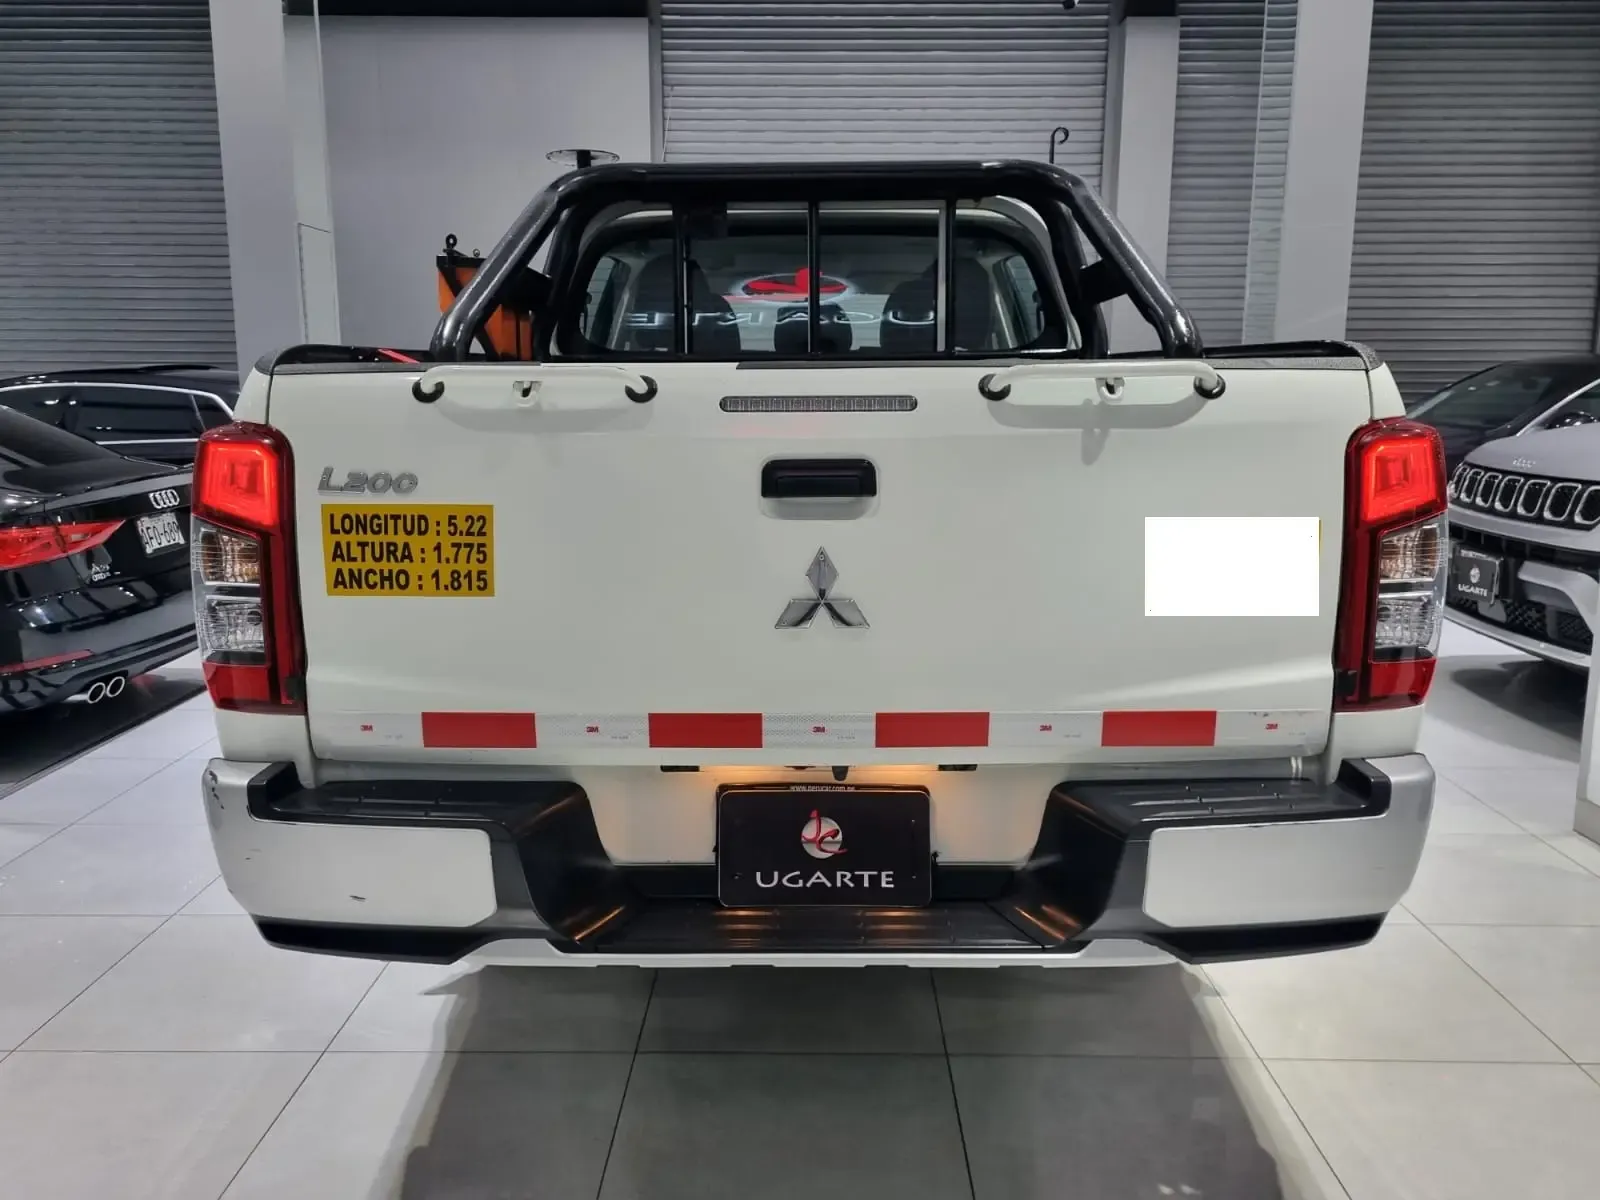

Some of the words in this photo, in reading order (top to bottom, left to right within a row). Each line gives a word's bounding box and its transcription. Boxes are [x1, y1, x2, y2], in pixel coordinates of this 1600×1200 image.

[317, 466, 418, 495] L200
[329, 513, 429, 536] LONGITUD
[447, 515, 487, 537] 5.22
[331, 541, 414, 563] ALTURA
[433, 542, 487, 564] 1.775
[333, 568, 410, 590] ANCHO
[431, 570, 488, 591] 1.815
[1458, 583, 1488, 597] UGARTE
[755, 871, 895, 888] UGARTE
